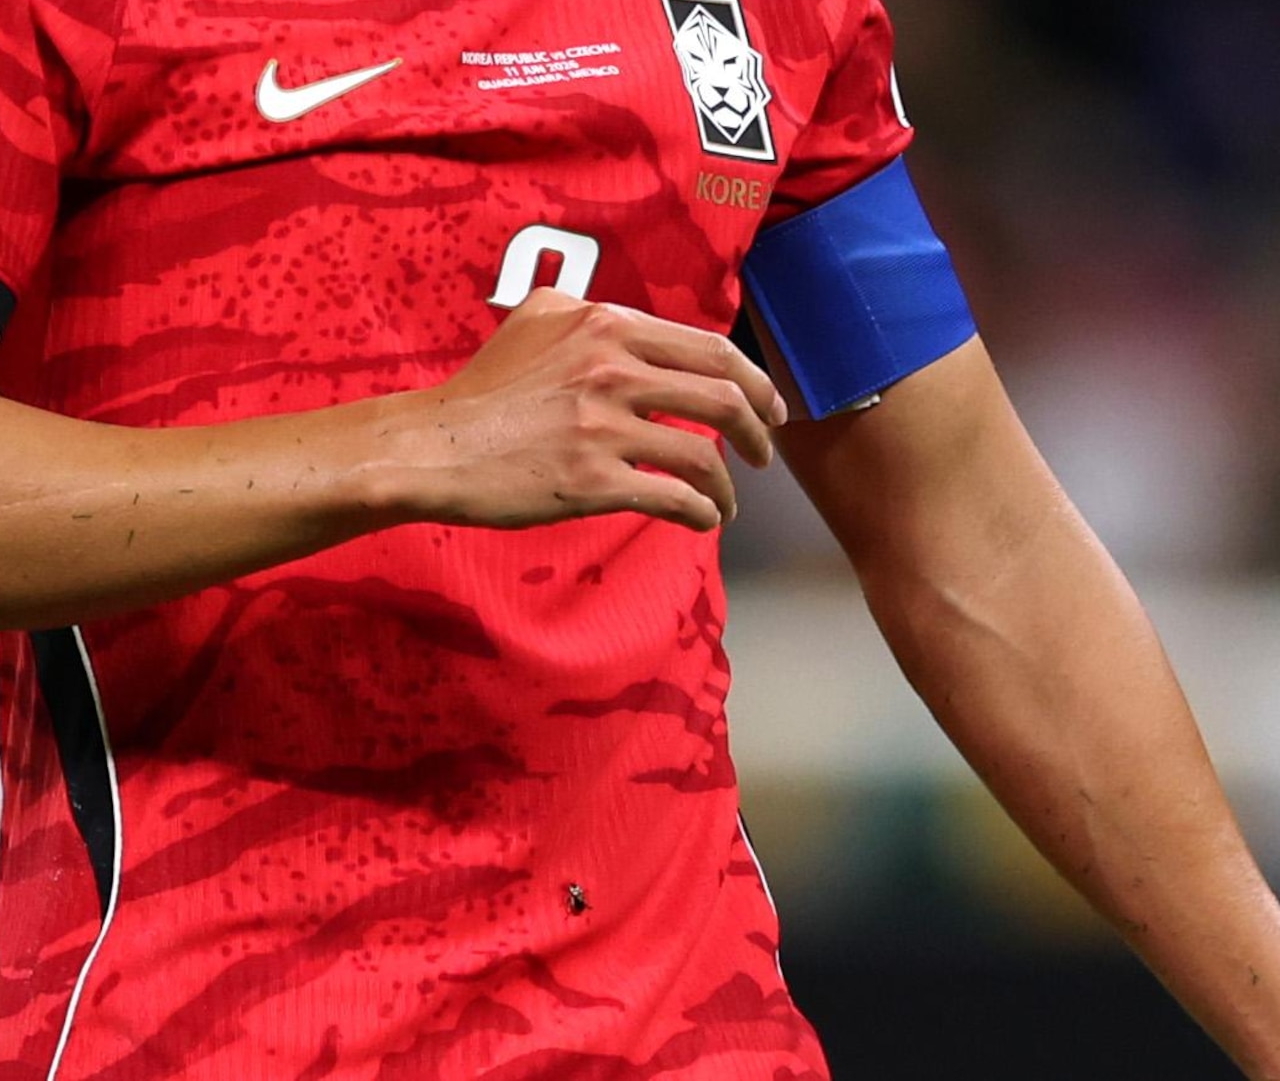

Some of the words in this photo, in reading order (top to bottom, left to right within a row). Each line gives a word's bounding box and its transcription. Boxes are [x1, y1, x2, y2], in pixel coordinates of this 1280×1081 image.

[462, 51, 493, 65] KOREA
[494, 51, 549, 65] REPUBLIC
[566, 43, 621, 58] CZECHIA
[478, 73, 569, 90] GUADALAJARA,
[569, 65, 620, 79] MEXICO
[503, 66, 520, 77] 11
[521, 64, 546, 76] JUN
[547, 60, 579, 73] 2026
